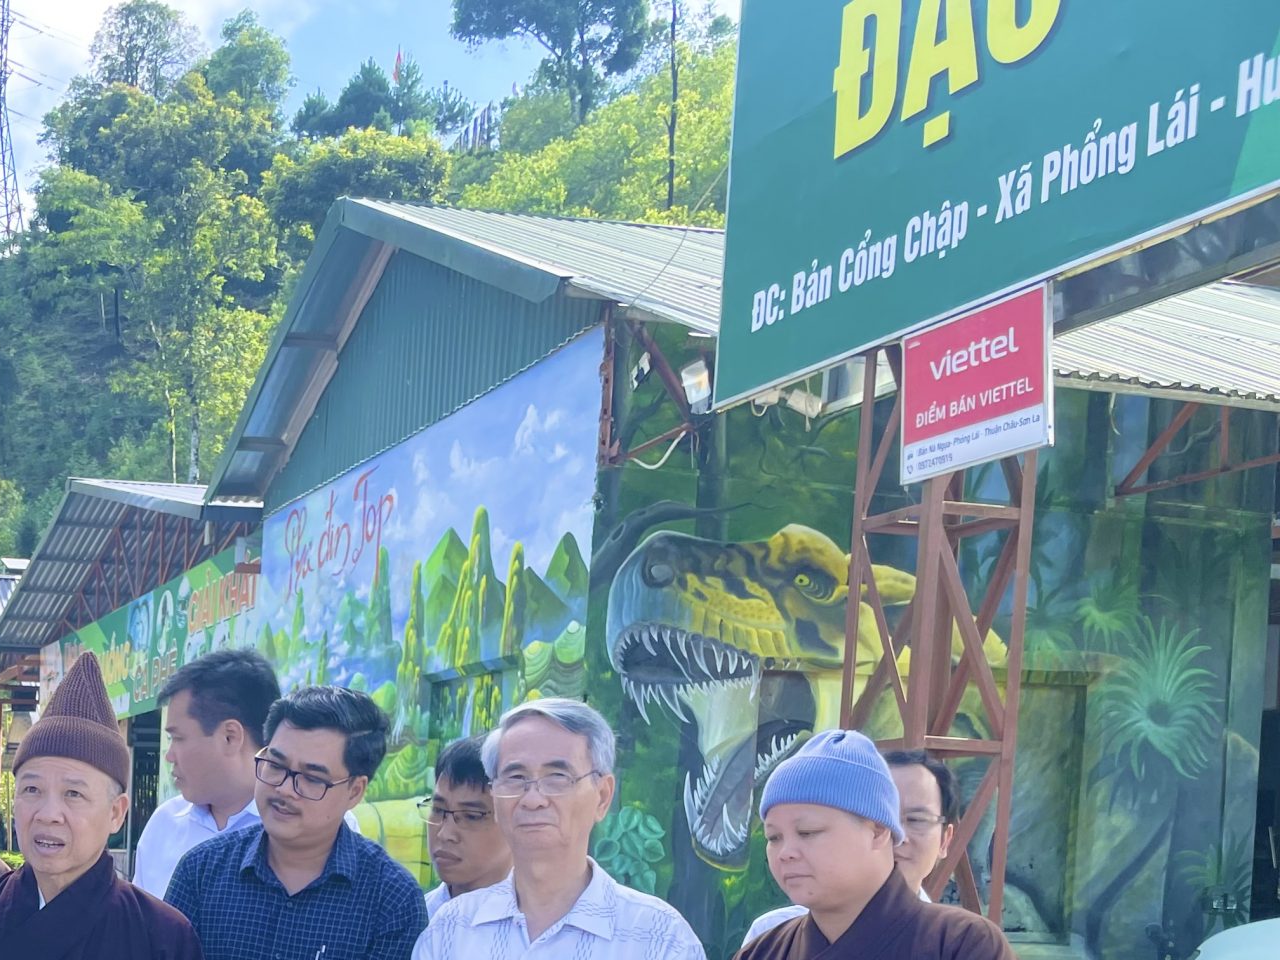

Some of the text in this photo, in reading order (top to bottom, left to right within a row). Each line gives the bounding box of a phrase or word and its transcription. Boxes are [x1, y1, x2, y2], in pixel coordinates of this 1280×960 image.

[750, 283, 786, 333] ĐC:
[790, 258, 833, 315] Bản
[838, 229, 897, 293] Cổng
[904, 200, 969, 263] Chập
[994, 161, 1033, 224] Xã
[1040, 117, 1138, 204] Phổng
[1147, 82, 1200, 157] Lái
[930, 327, 1019, 380] viettel
[916, 377, 1034, 428] ĐIỂM BÁN VIETTEL
